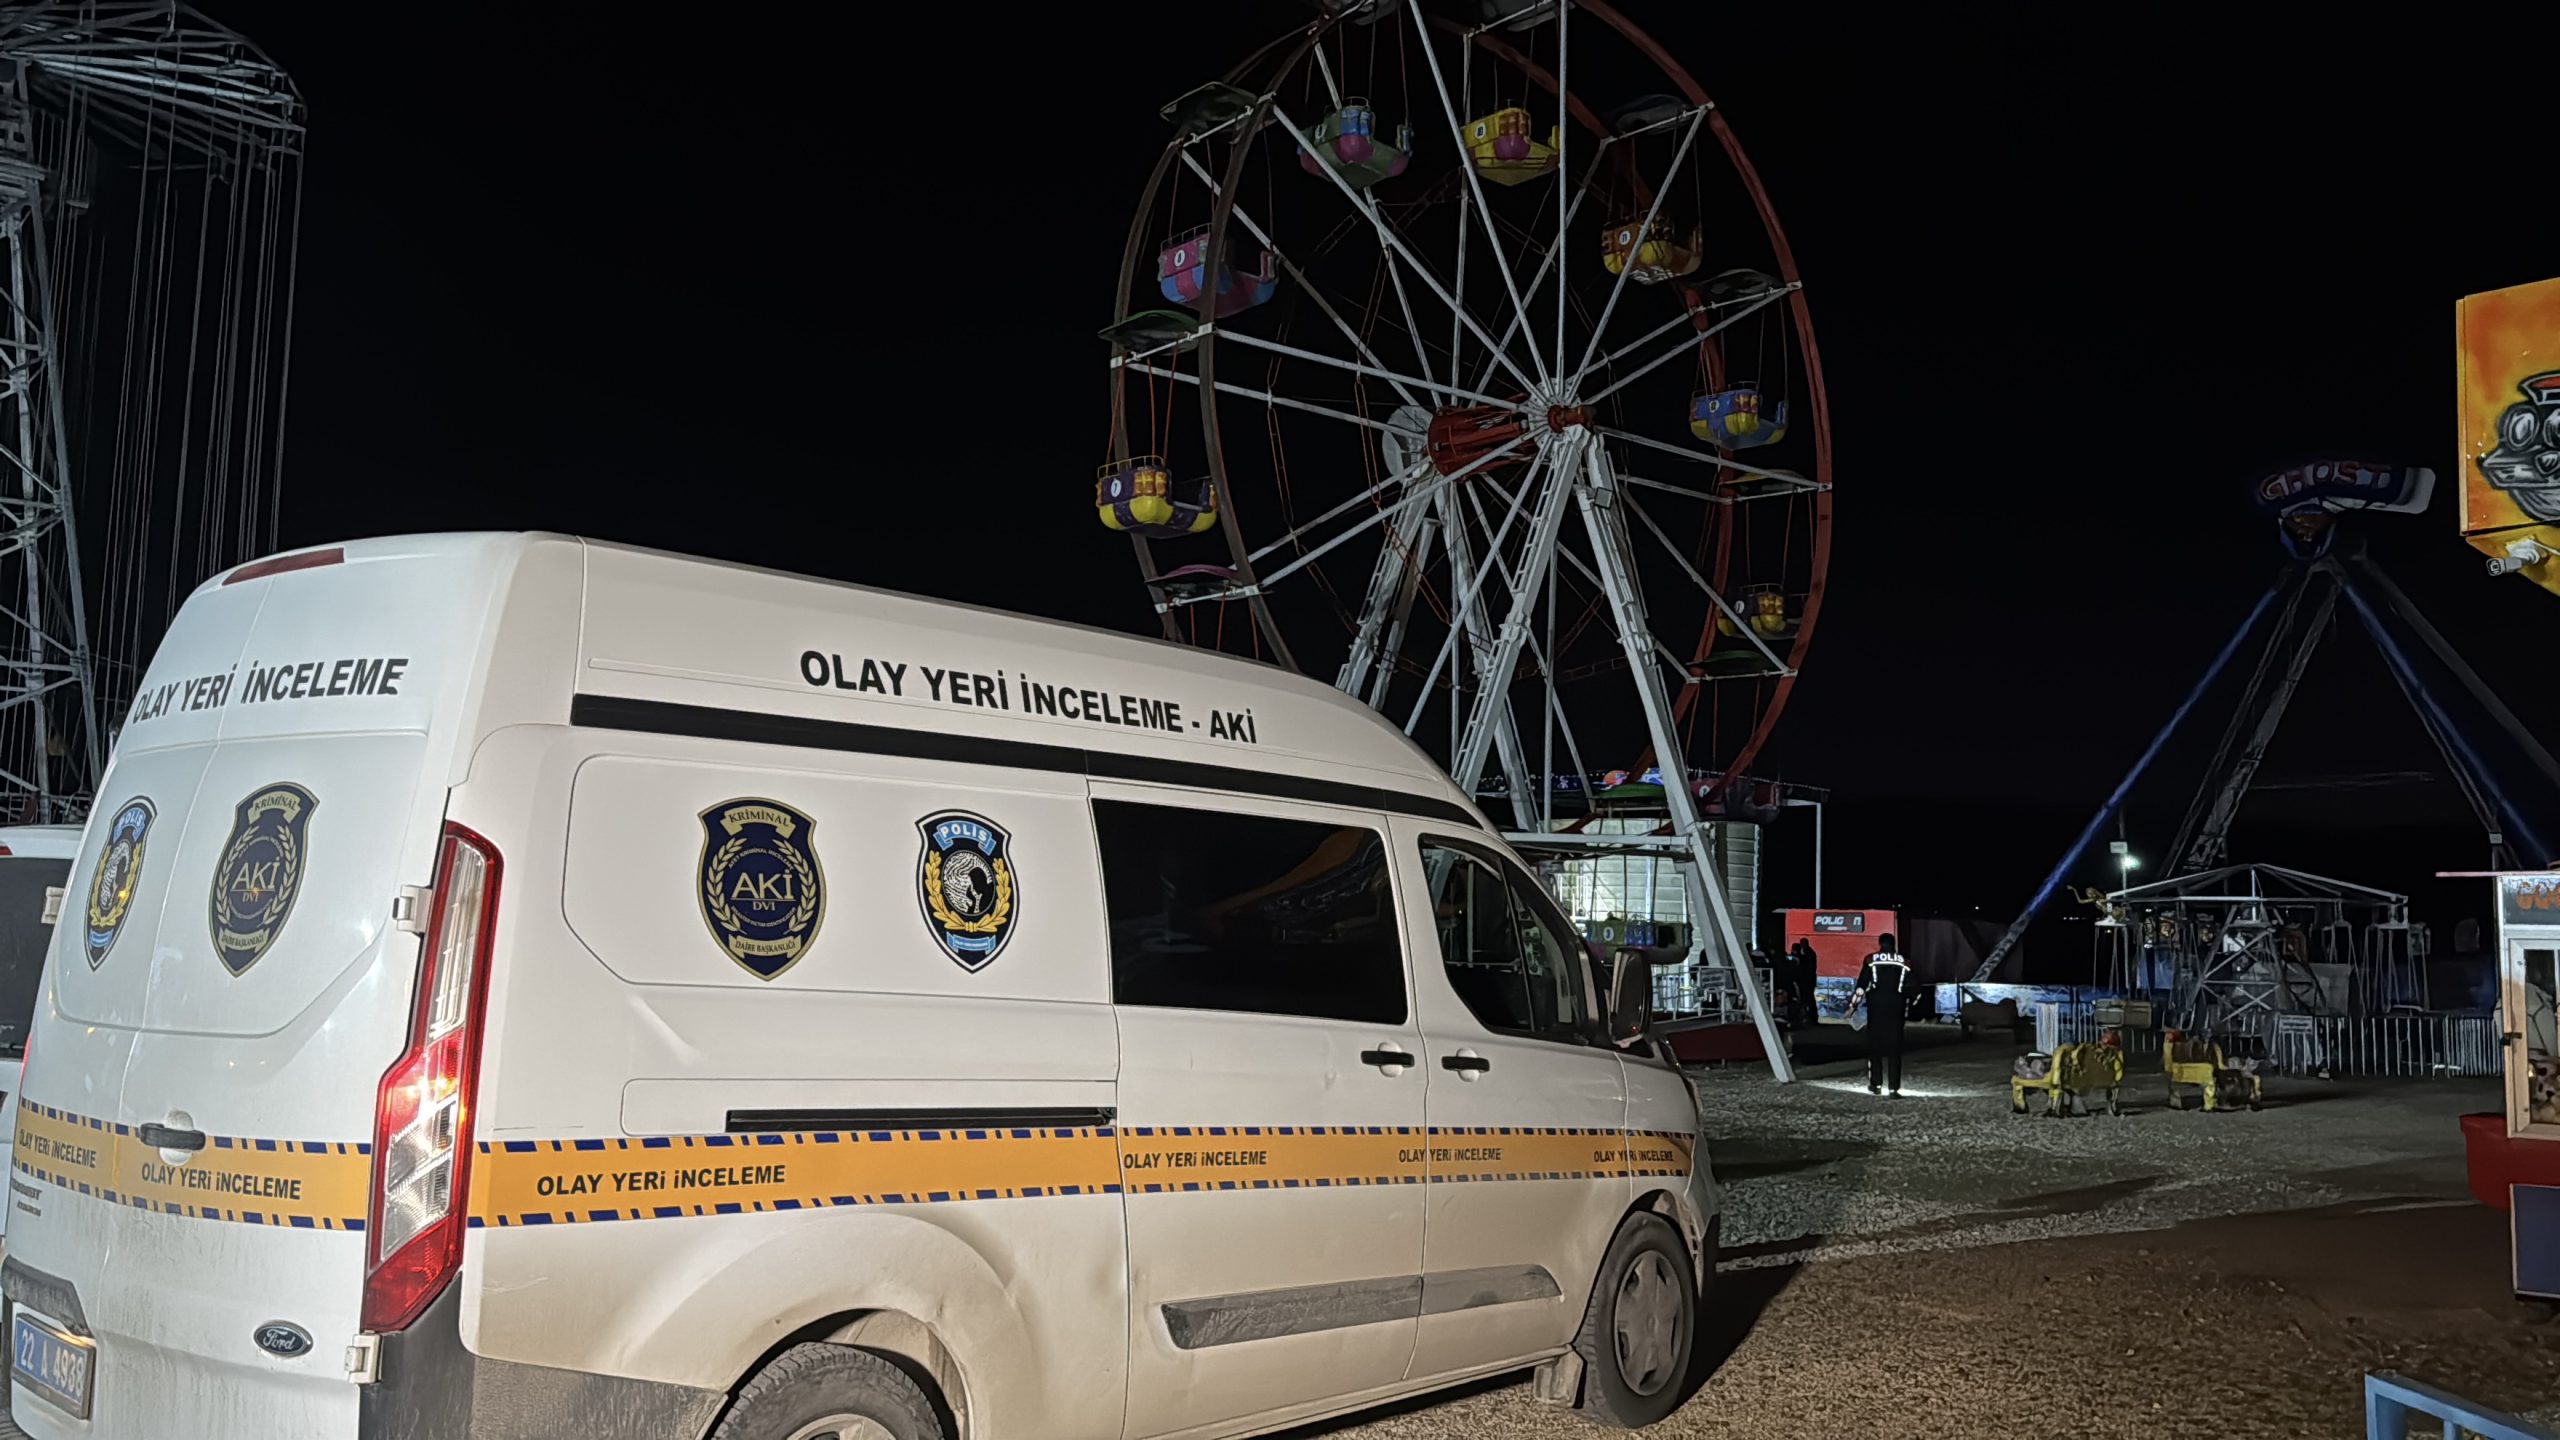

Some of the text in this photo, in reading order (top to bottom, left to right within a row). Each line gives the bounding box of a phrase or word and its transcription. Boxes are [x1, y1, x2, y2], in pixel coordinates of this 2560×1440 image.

[132, 658, 408, 724] OLAY YERİ İNCELEME
[799, 650, 907, 697] OLAY
[919, 665, 1008, 711] YERİ
[1019, 672, 1184, 734] İNCELEME
[1209, 707, 1258, 745] AKİ
[728, 809, 789, 827] KRİMİNAL
[231, 856, 280, 889] AKİ
[731, 869, 795, 899] AKİ
[752, 901, 776, 911] DVI
[1124, 1153, 1160, 1168] OLAY
[1399, 1149, 1426, 1162] OLAY
[1594, 1150, 1615, 1162] OLAY
[142, 1163, 176, 1185] OLAY
[537, 1173, 603, 1196] OLAY
[262, 1328, 296, 1350] Ford
[21, 1328, 84, 1398] 22 A 4938
